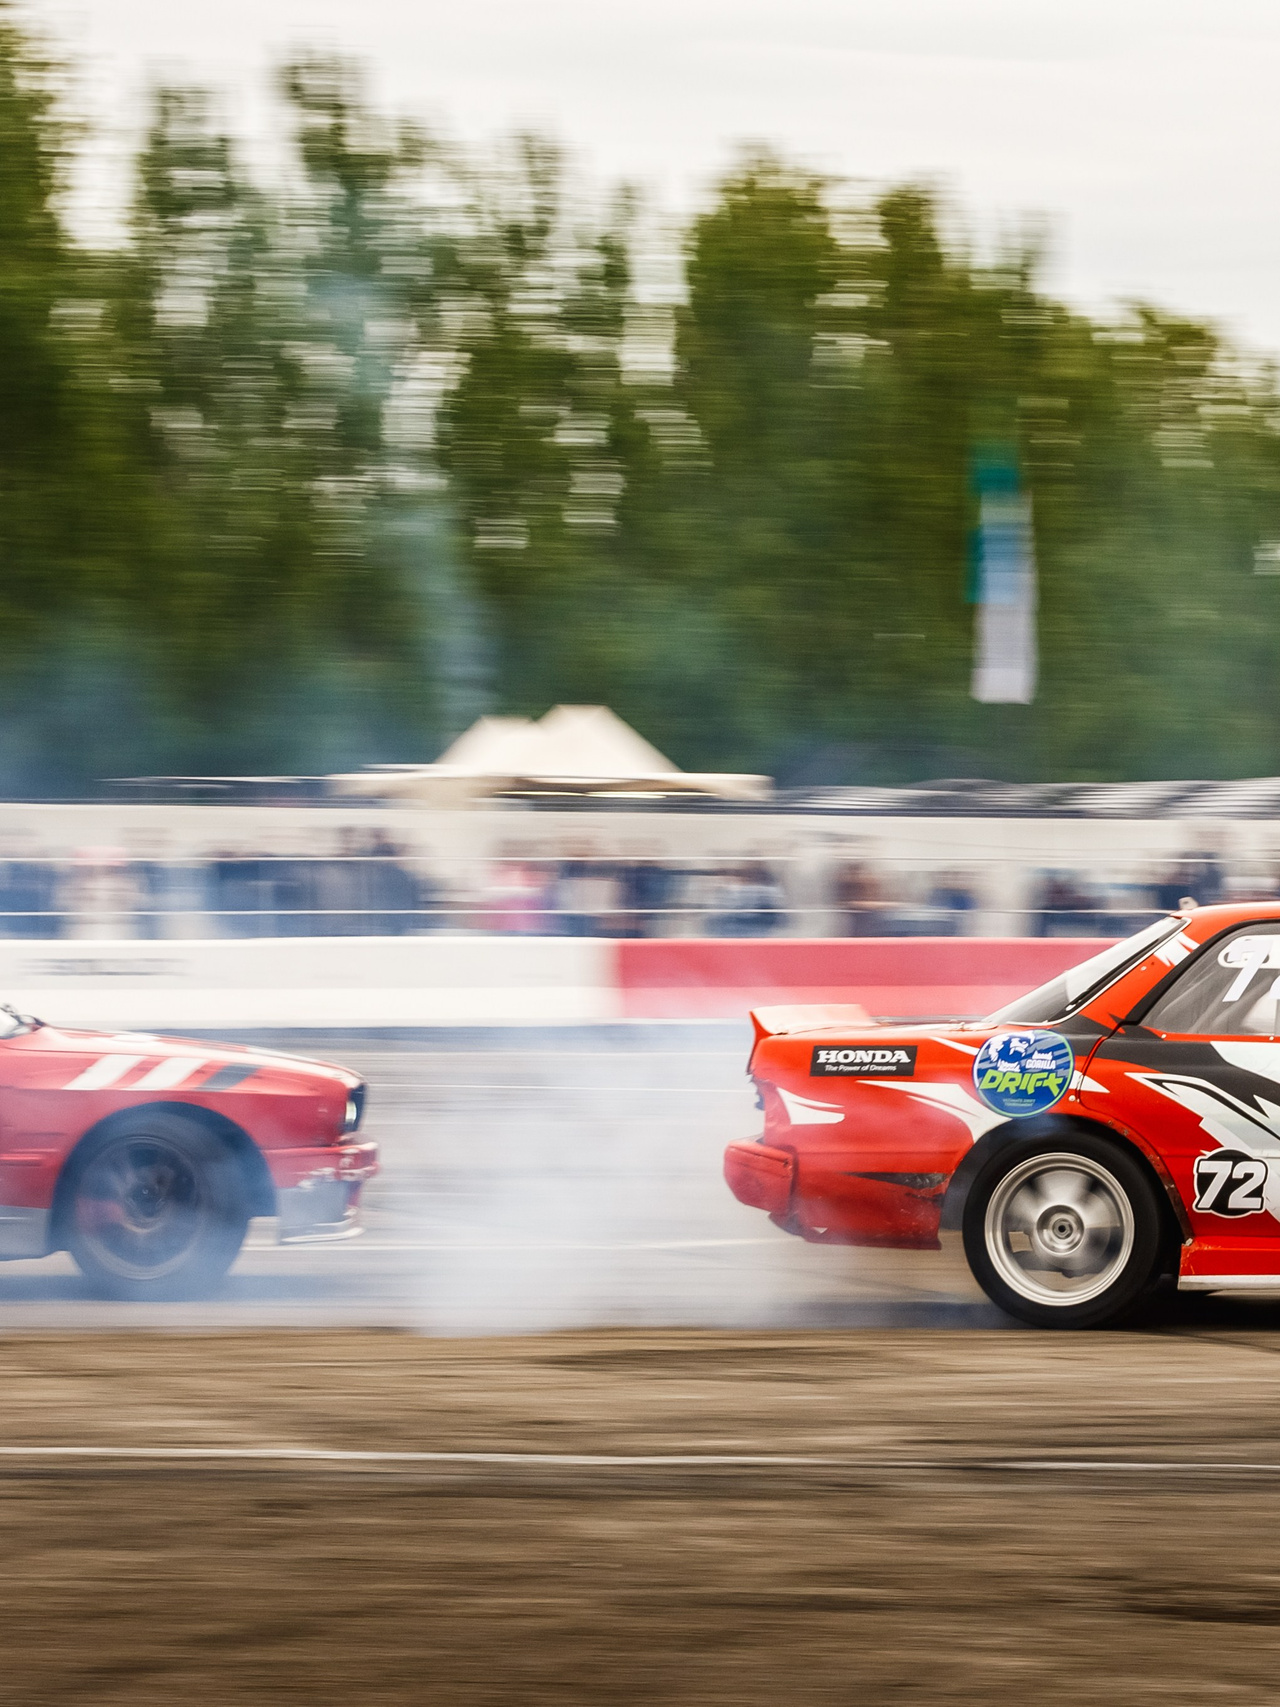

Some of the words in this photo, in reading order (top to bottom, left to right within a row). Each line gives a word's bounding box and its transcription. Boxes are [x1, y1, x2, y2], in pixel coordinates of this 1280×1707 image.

[816, 1050, 912, 1063] HONDA
[861, 1064, 870, 1072] of
[1025, 1059, 1056, 1070] GORILLA
[1197, 1160, 1267, 1209] 72
